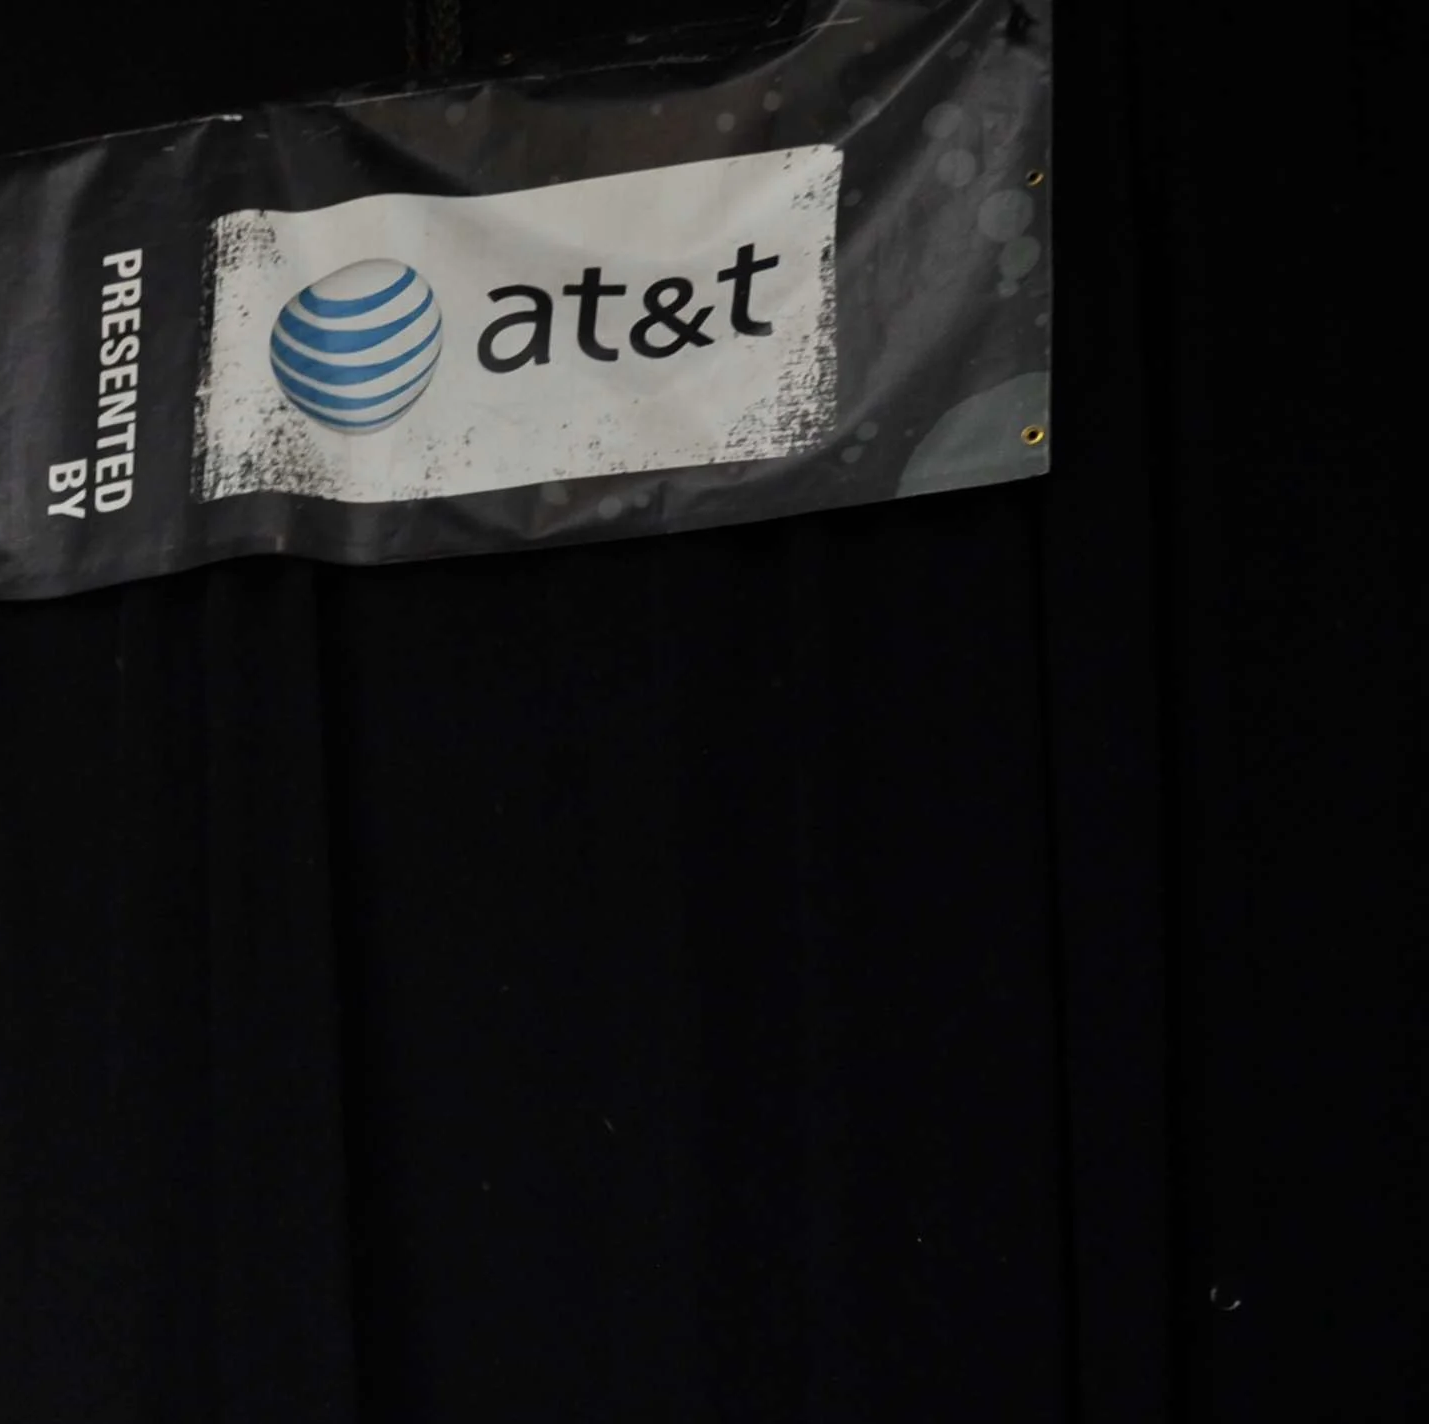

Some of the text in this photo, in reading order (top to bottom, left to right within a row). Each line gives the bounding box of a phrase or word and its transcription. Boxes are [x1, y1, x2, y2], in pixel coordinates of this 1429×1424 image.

[475, 241, 781, 374] at&t
[91, 247, 143, 515] PRESENTED
[47, 458, 88, 520] BY
